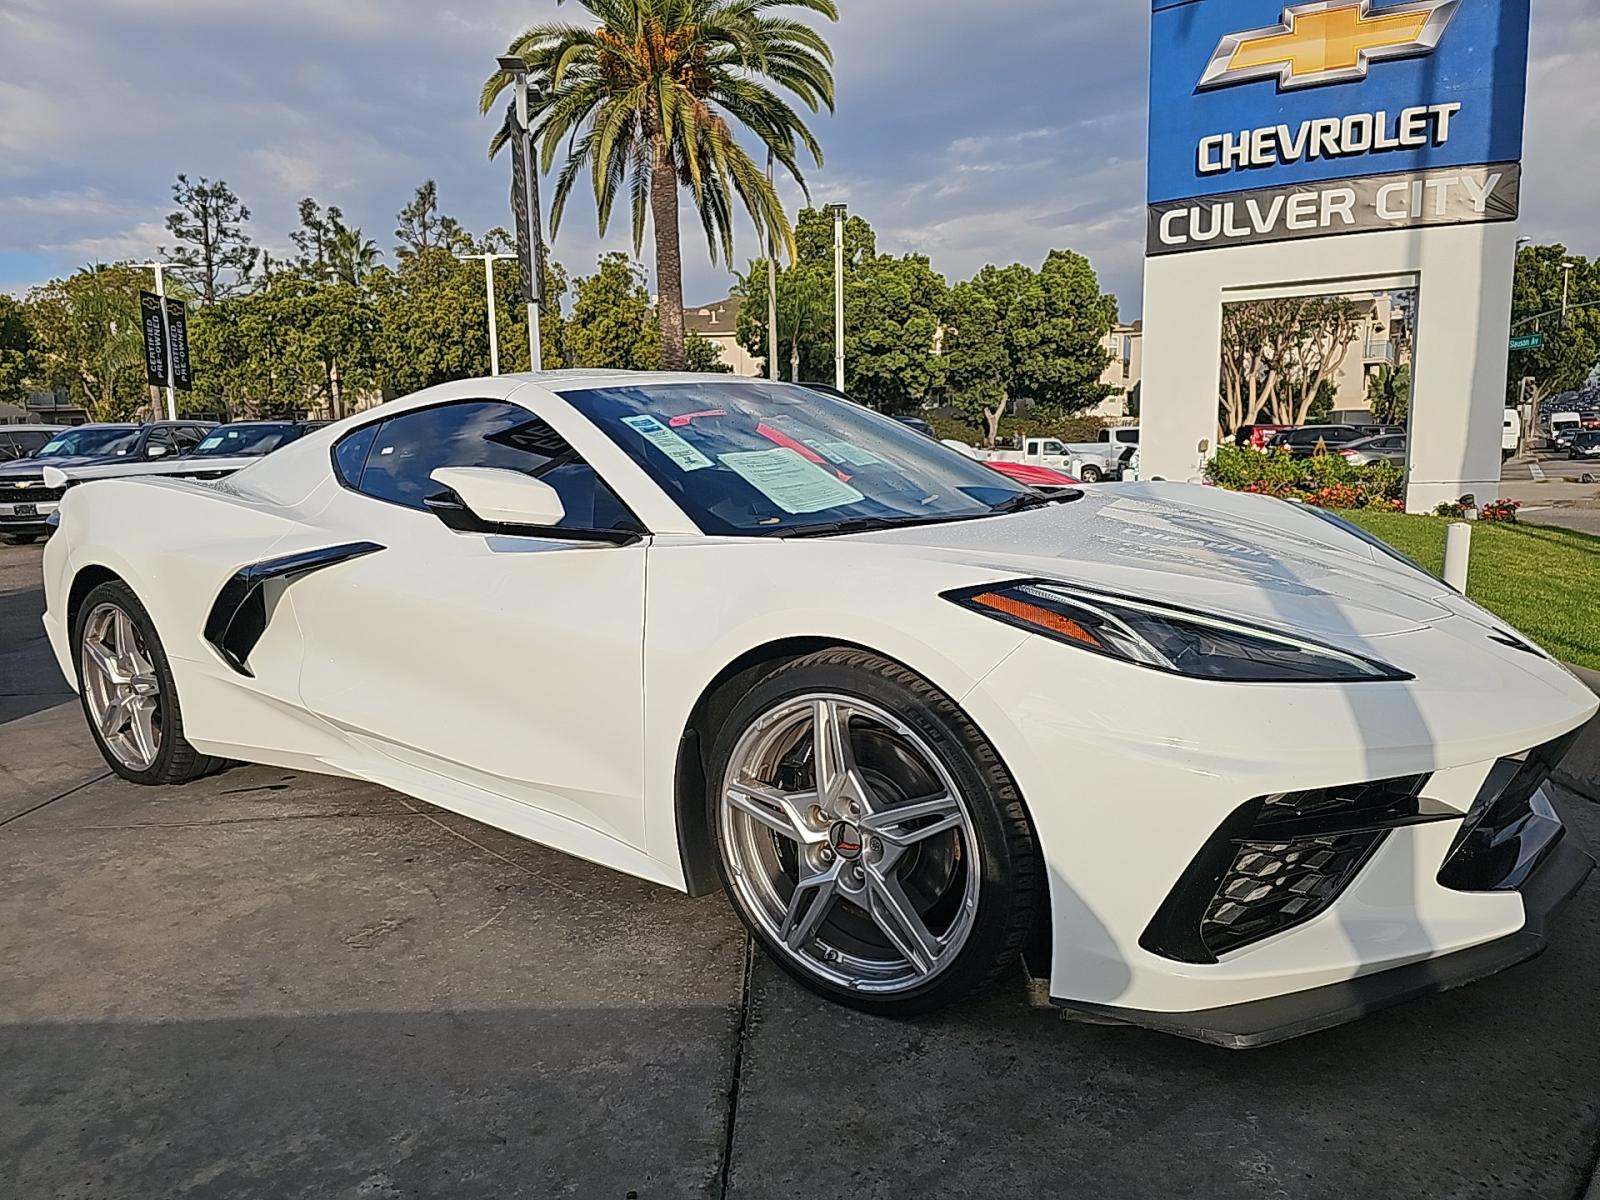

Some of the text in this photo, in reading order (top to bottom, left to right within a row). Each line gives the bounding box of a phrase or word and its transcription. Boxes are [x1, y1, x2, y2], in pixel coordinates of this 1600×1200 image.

[1198, 102, 1461, 173] CHEVROLET
[1159, 173, 1502, 245] CULVER CITY
[146, 319, 157, 372] CERTIFIED
[152, 315, 164, 378] PRE-OWNED
[170, 325, 181, 376] CERTIFIED
